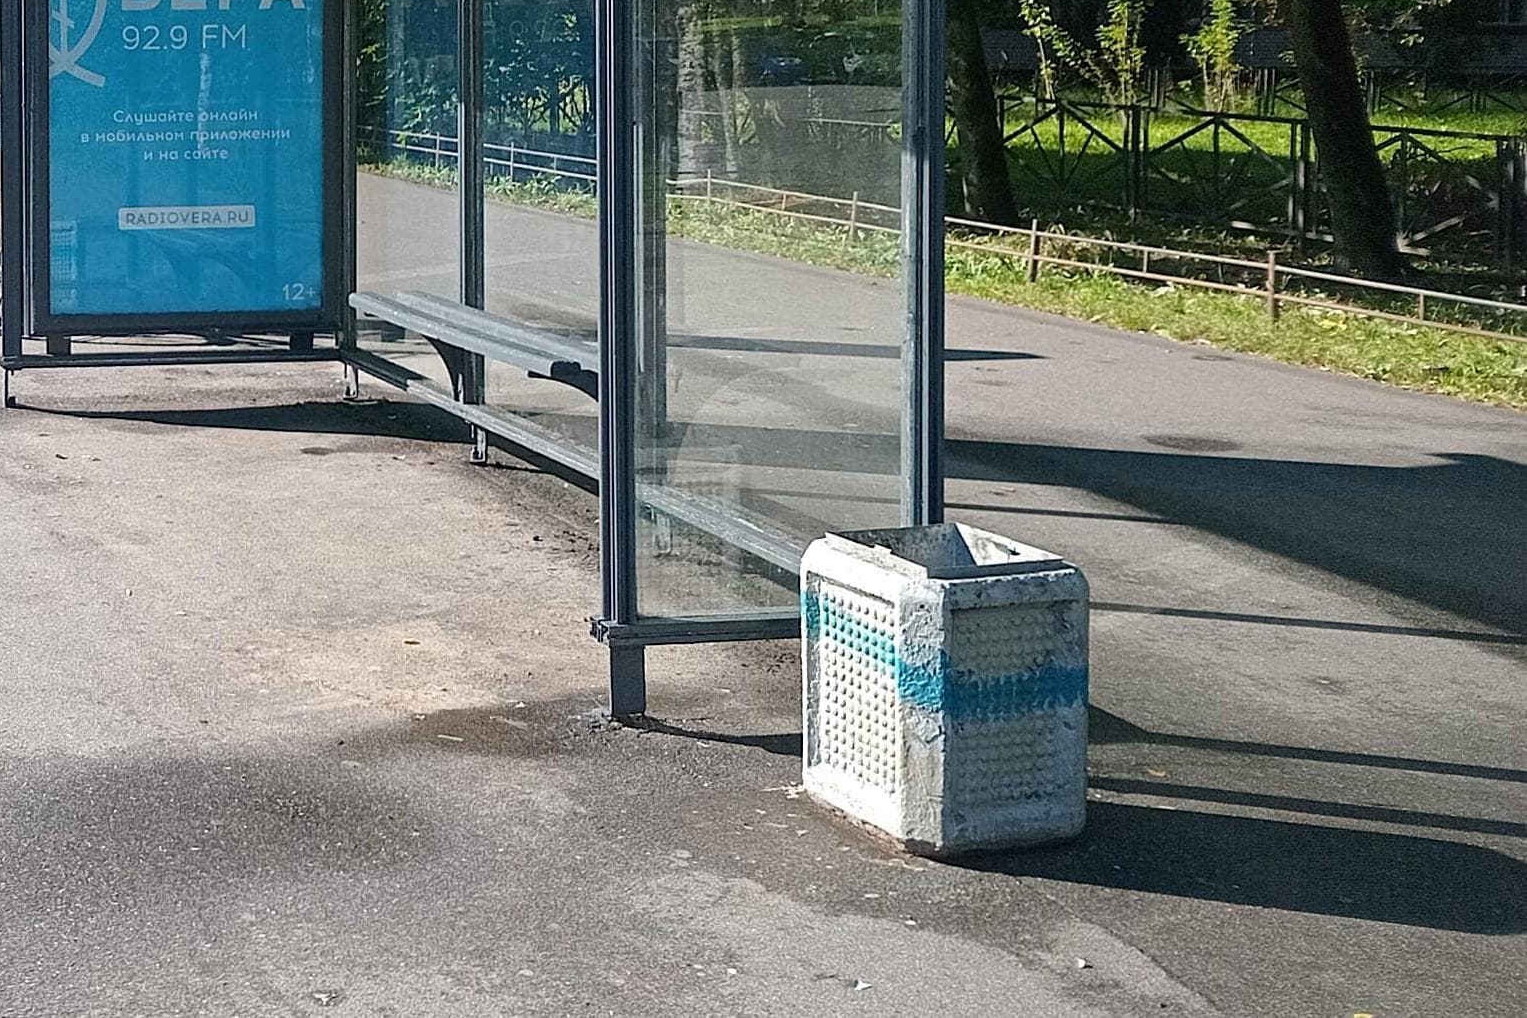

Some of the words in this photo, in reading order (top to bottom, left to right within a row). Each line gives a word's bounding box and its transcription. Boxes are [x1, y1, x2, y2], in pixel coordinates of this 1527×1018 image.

[122, 25, 188, 50] 92.9
[202, 24, 246, 49] FM
[113, 109, 194, 126] Слушайте
[199, 109, 258, 123] онлайн
[81, 134, 89, 143] в
[95, 129, 184, 142] мобильном
[190, 128, 291, 145] приложении
[144, 151, 153, 161] и
[159, 151, 179, 161] на
[184, 147, 228, 161] сайте
[125, 210, 249, 225] RADIOVERA.RU
[282, 283, 316, 301] 12+
